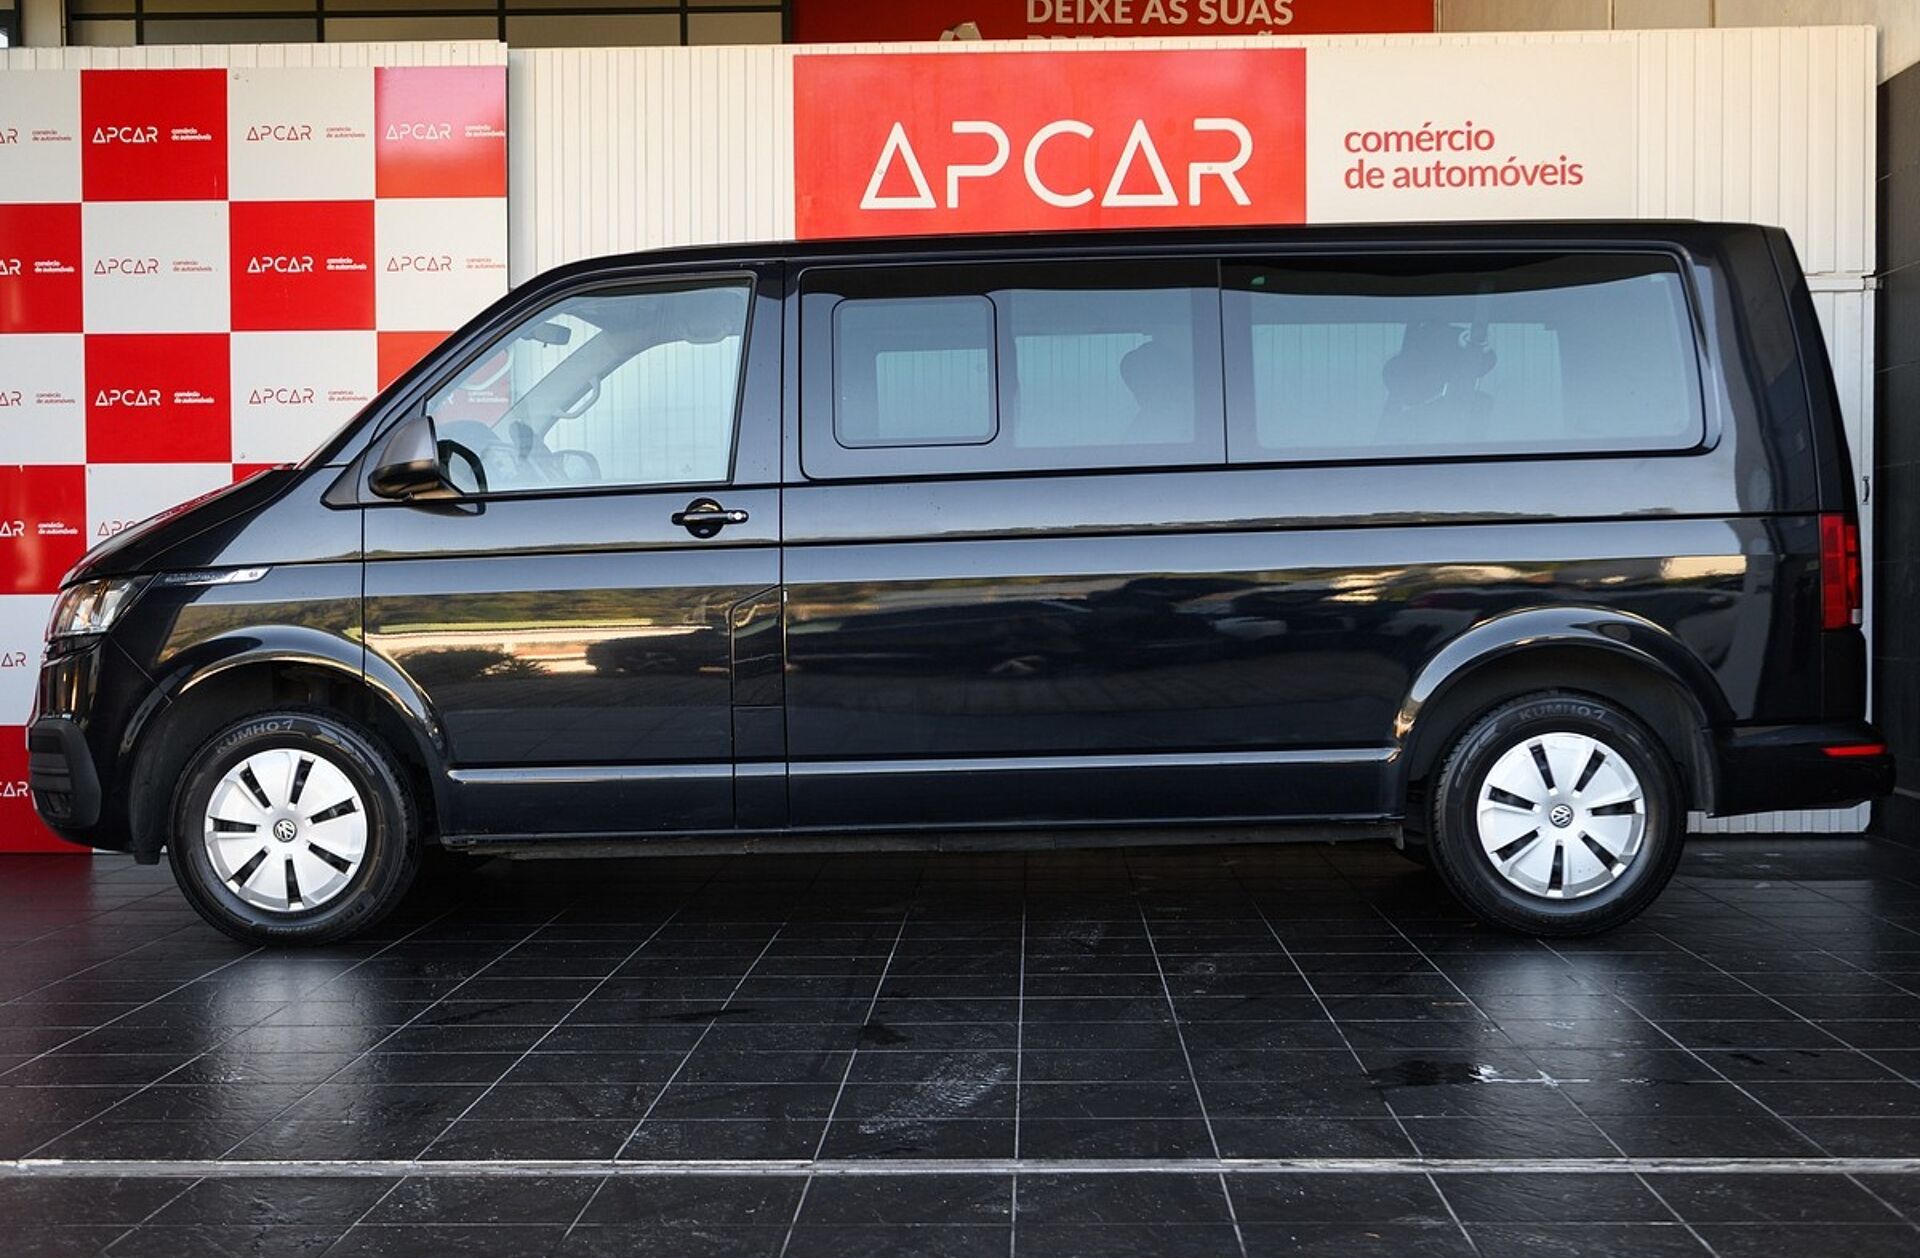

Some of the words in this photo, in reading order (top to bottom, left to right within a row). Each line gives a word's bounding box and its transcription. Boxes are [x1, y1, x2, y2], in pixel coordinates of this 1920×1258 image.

[1027, 0, 1134, 24] DEIXE
[1141, 0, 1189, 24] AS
[1198, 0, 1294, 24] SUAS
[92, 127, 158, 143] APCAR
[246, 126, 312, 141] APCAR
[386, 124, 452, 140] APCAR
[1344, 121, 1495, 153] comércio
[859, 117, 1253, 209] APCAR
[1344, 159, 1385, 189] de
[1392, 155, 1584, 188] automóveis
[94, 258, 159, 274] APCAR
[247, 256, 313, 273] APCAR
[387, 256, 452, 271] APCAR
[95, 389, 161, 406] APCAR
[249, 388, 314, 404] APCAR
